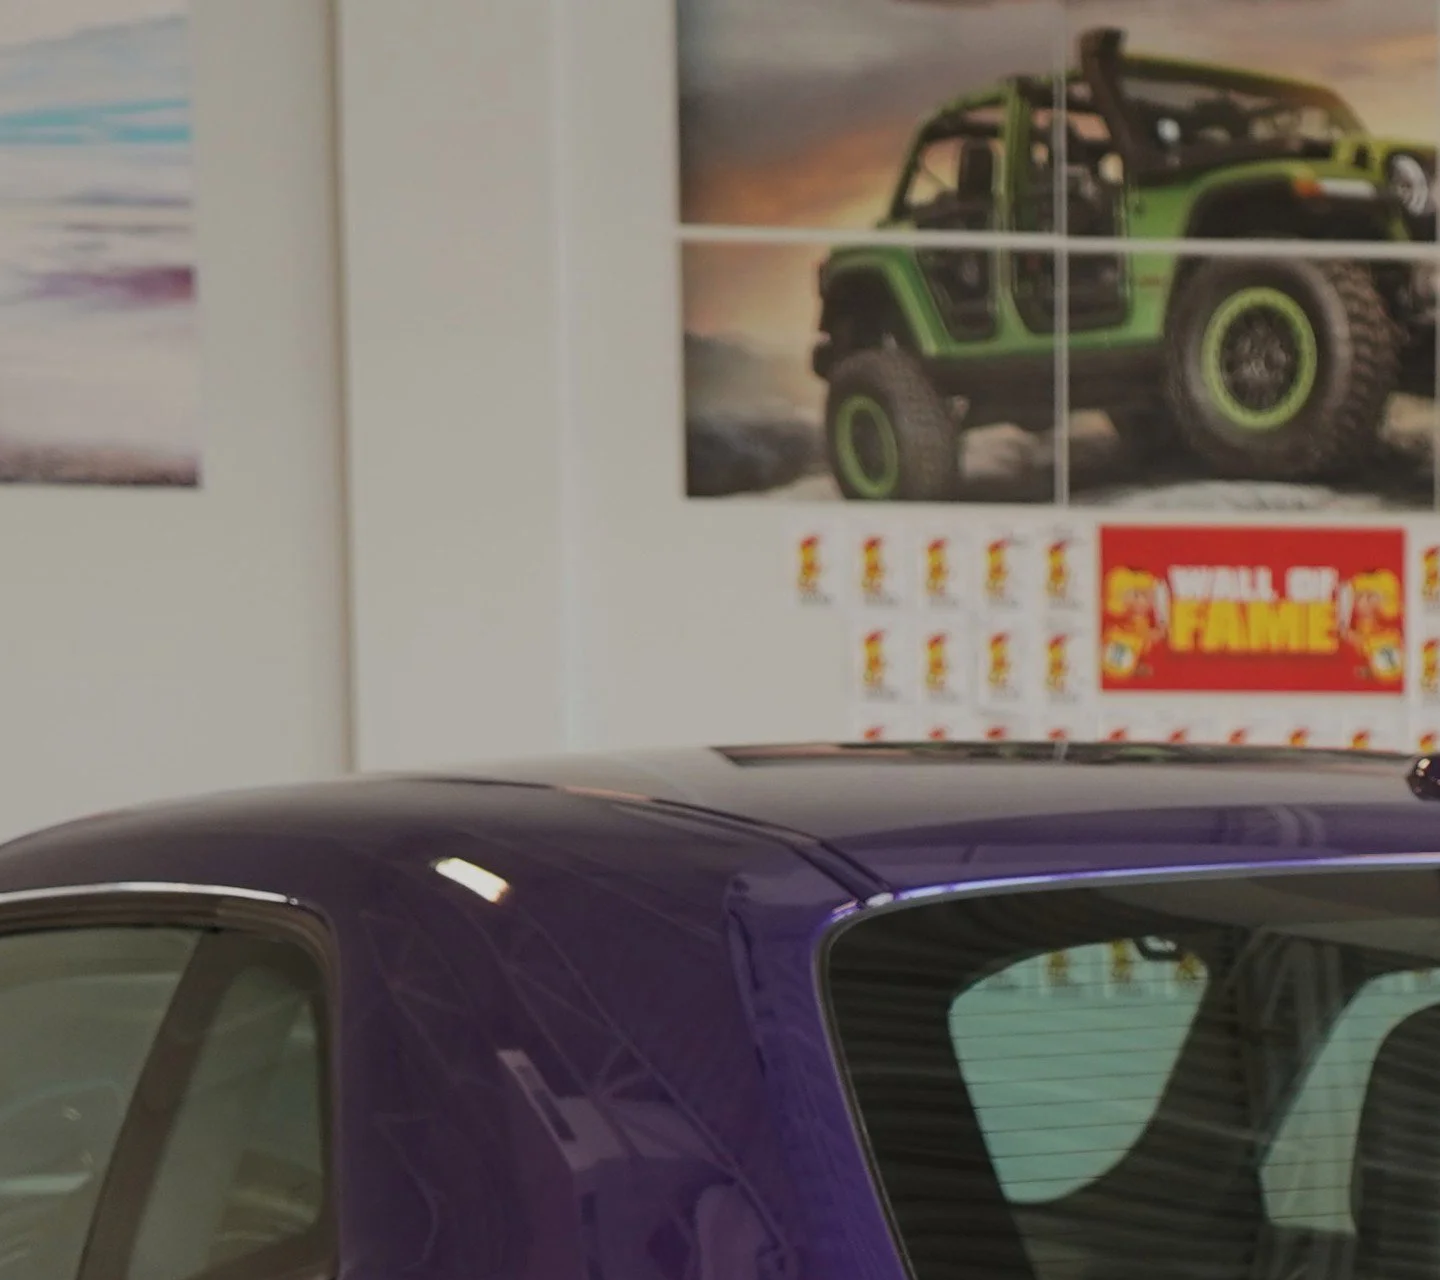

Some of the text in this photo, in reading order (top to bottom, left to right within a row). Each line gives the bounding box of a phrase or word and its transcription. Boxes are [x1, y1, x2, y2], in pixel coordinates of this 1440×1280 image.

[1167, 564, 1339, 603] WALL OF
[1169, 600, 1339, 654] FAME
